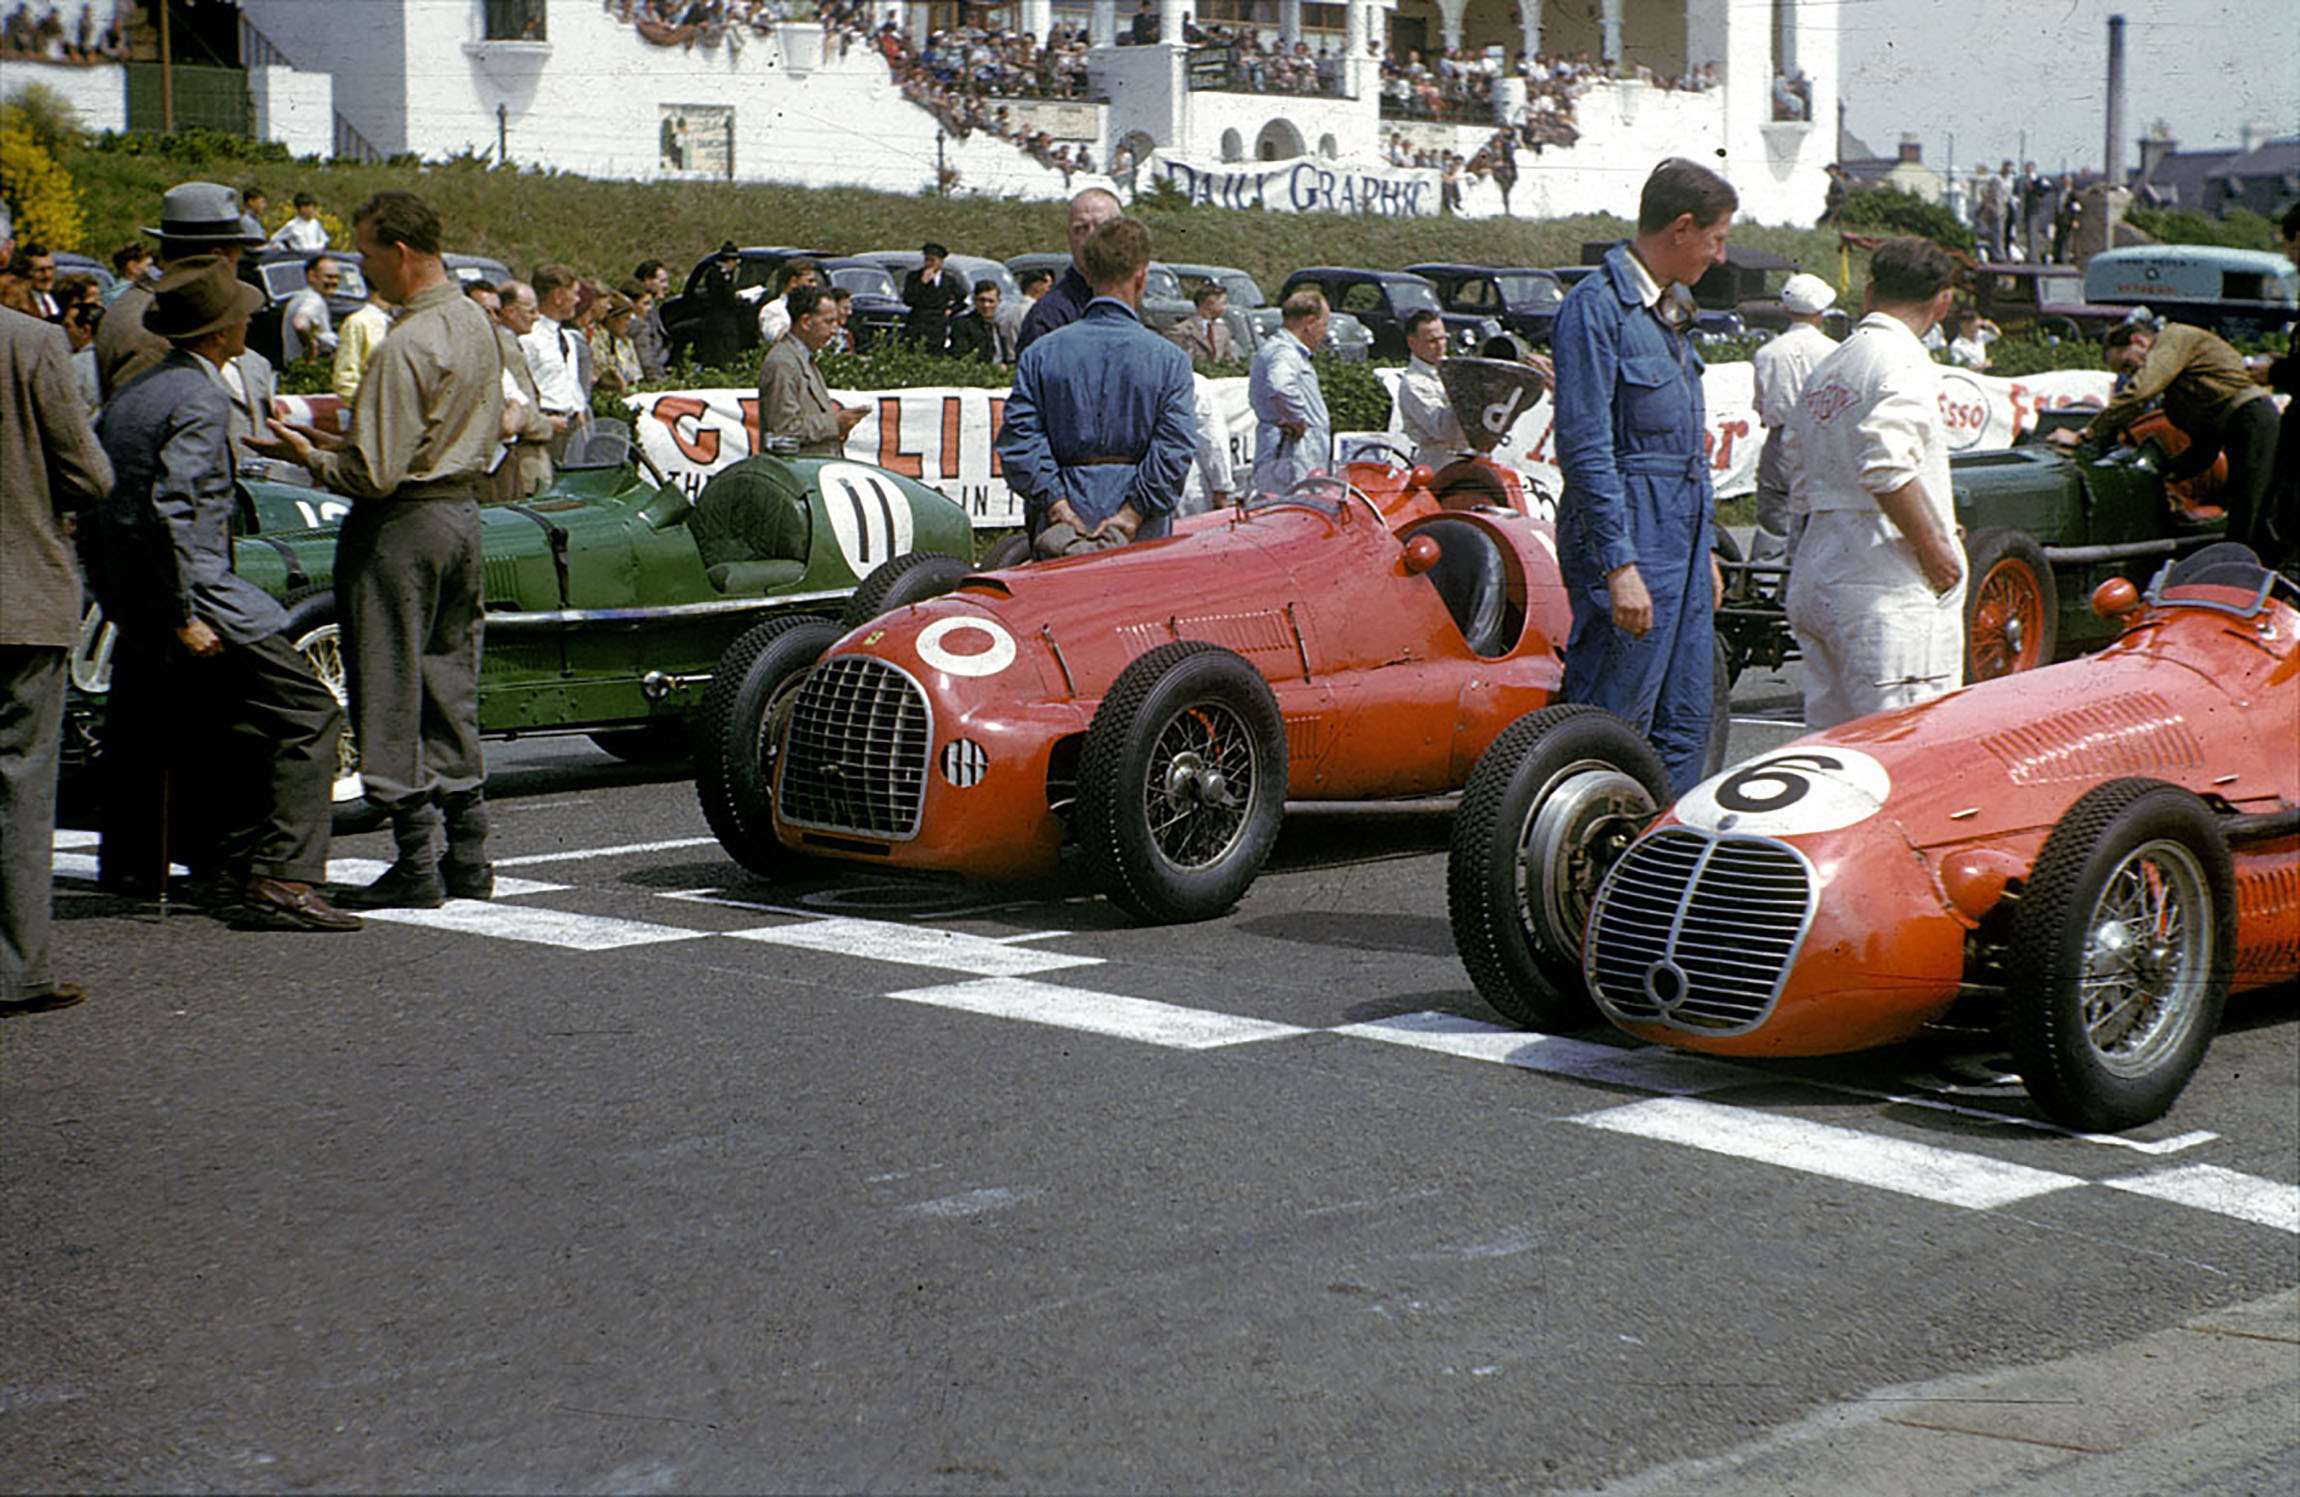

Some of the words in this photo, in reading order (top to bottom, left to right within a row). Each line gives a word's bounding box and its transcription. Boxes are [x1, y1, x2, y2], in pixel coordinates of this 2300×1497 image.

[1289, 162, 1431, 217] GRAPHIC
[837, 477, 897, 564] 11
[1714, 754, 1844, 813] 6
